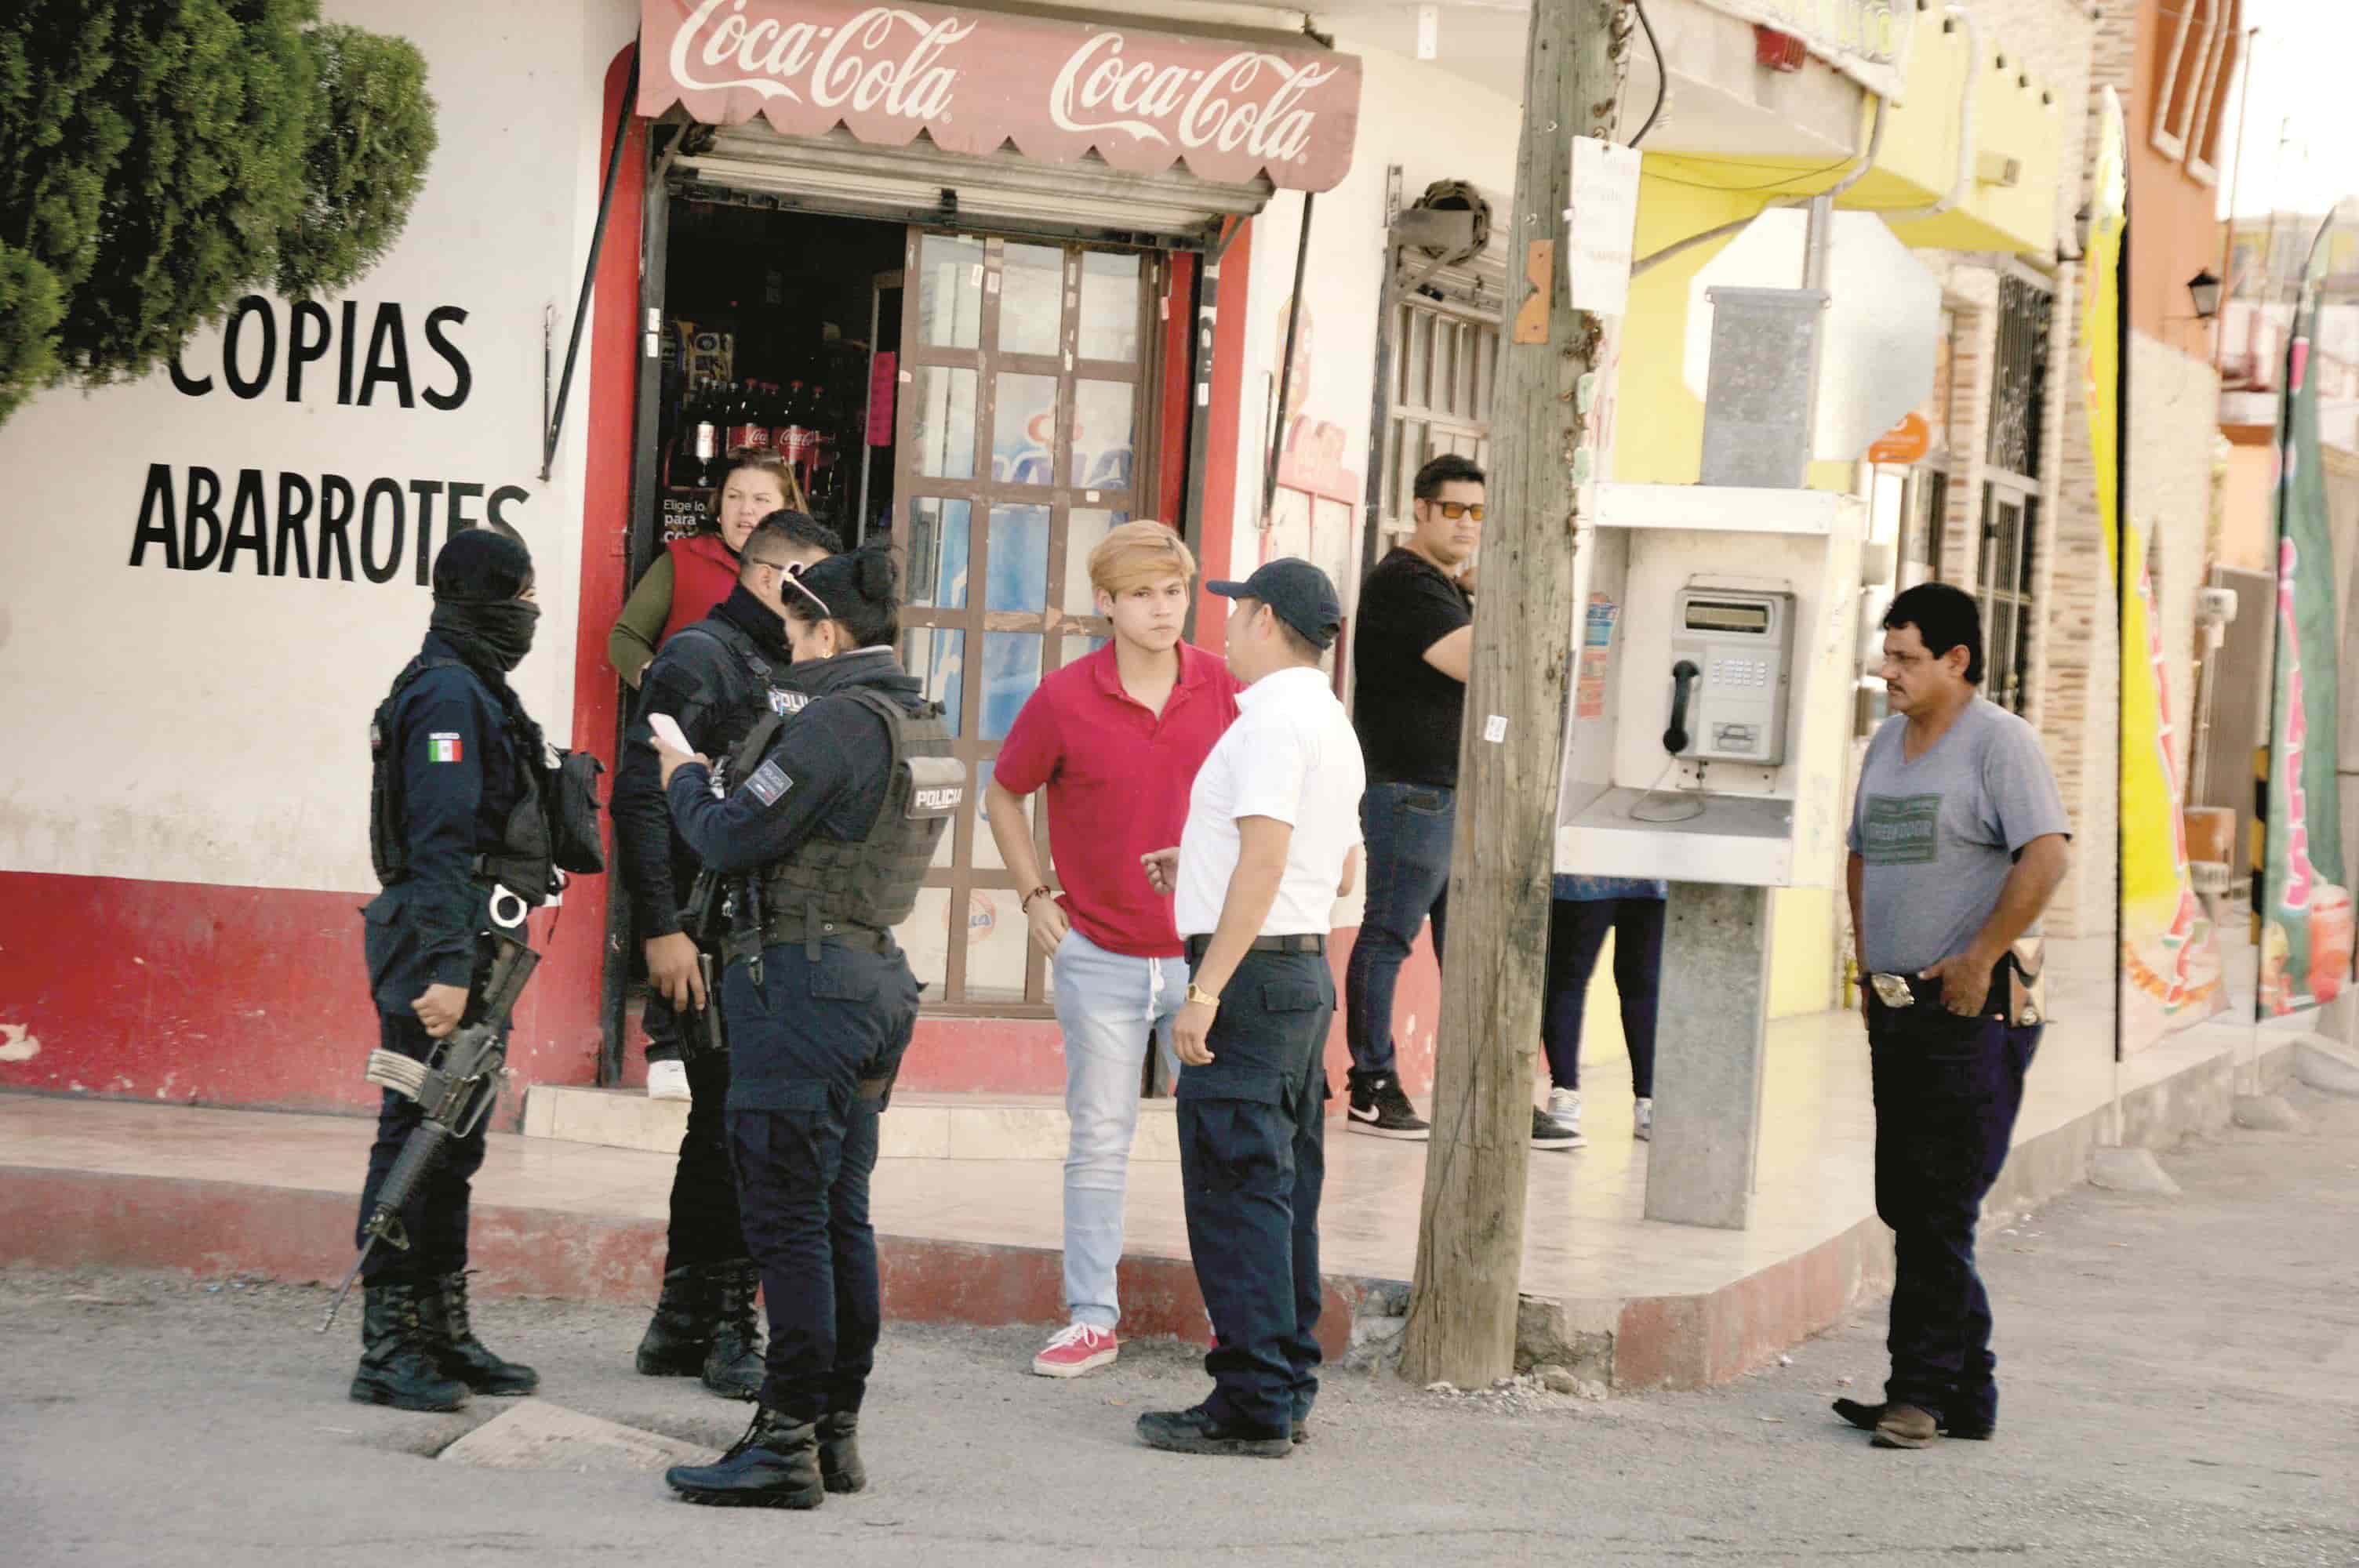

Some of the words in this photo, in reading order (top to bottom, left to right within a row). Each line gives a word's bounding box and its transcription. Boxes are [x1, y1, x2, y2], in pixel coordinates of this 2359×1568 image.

[670, 0, 978, 121] Coca-Cola
[1049, 31, 1340, 162] Coca-Cola
[664, 499, 691, 514] Elige
[128, 463, 531, 586] ABARROTES
[664, 514, 696, 527] para
[769, 689, 809, 713] POLI
[916, 788, 962, 807] POLICIA
